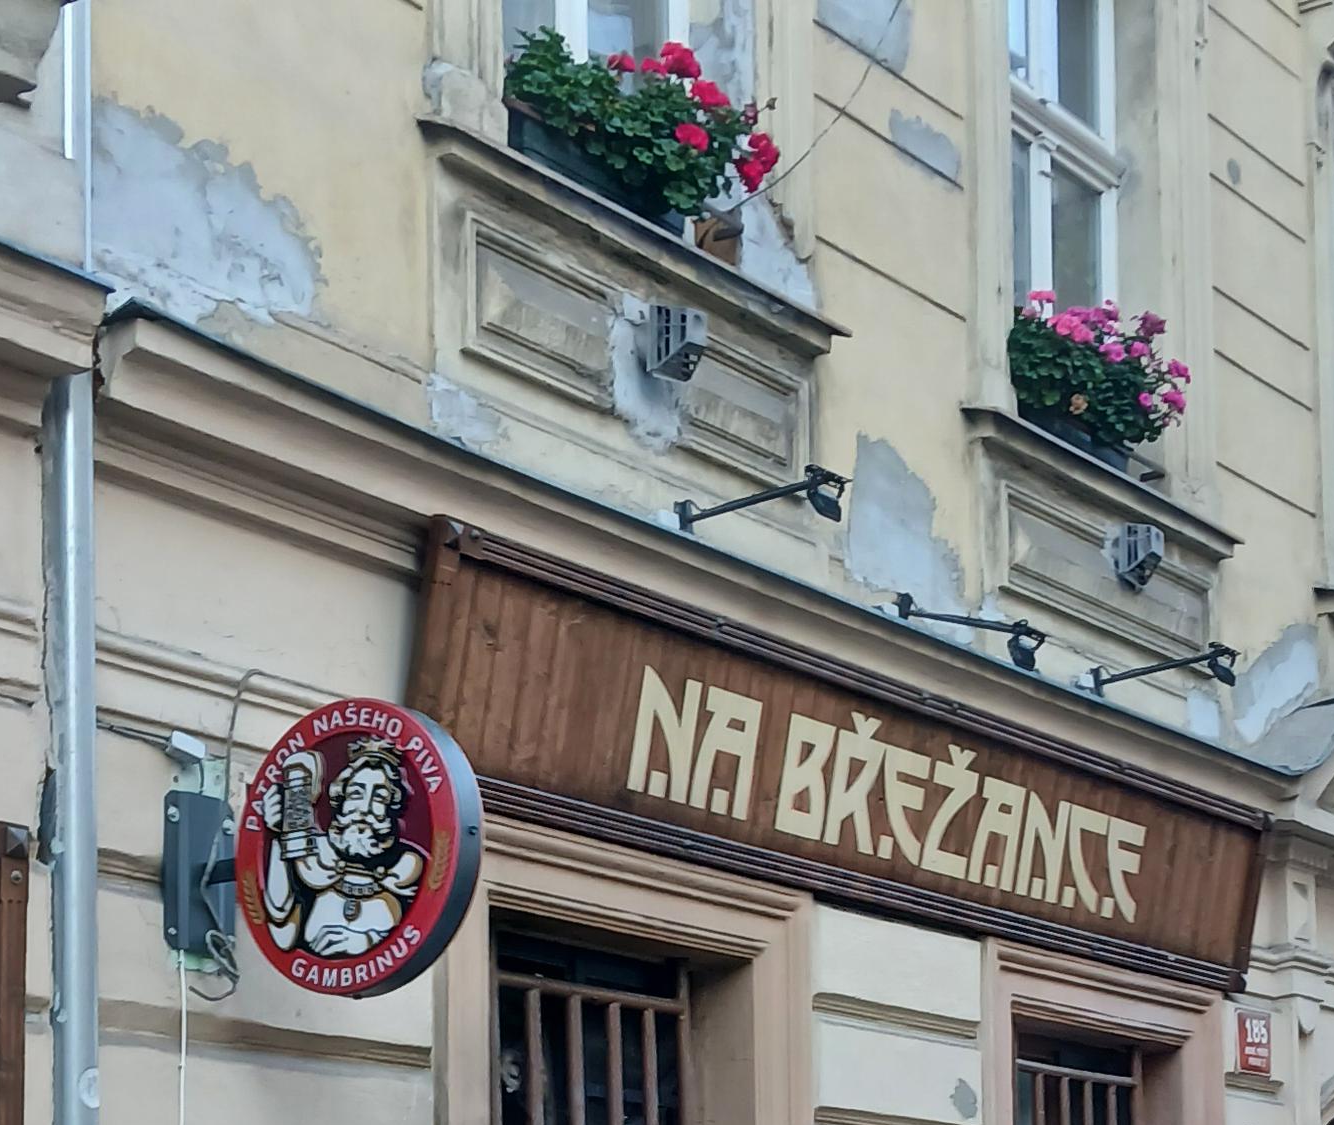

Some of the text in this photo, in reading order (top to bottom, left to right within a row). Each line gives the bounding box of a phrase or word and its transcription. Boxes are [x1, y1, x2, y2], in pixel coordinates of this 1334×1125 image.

[245, 702, 443, 831] PATRON NAŠEHO PIVA
[627, 664, 1147, 924] NA BŘEŽANCE
[291, 925, 421, 988] GAMBRINUS
